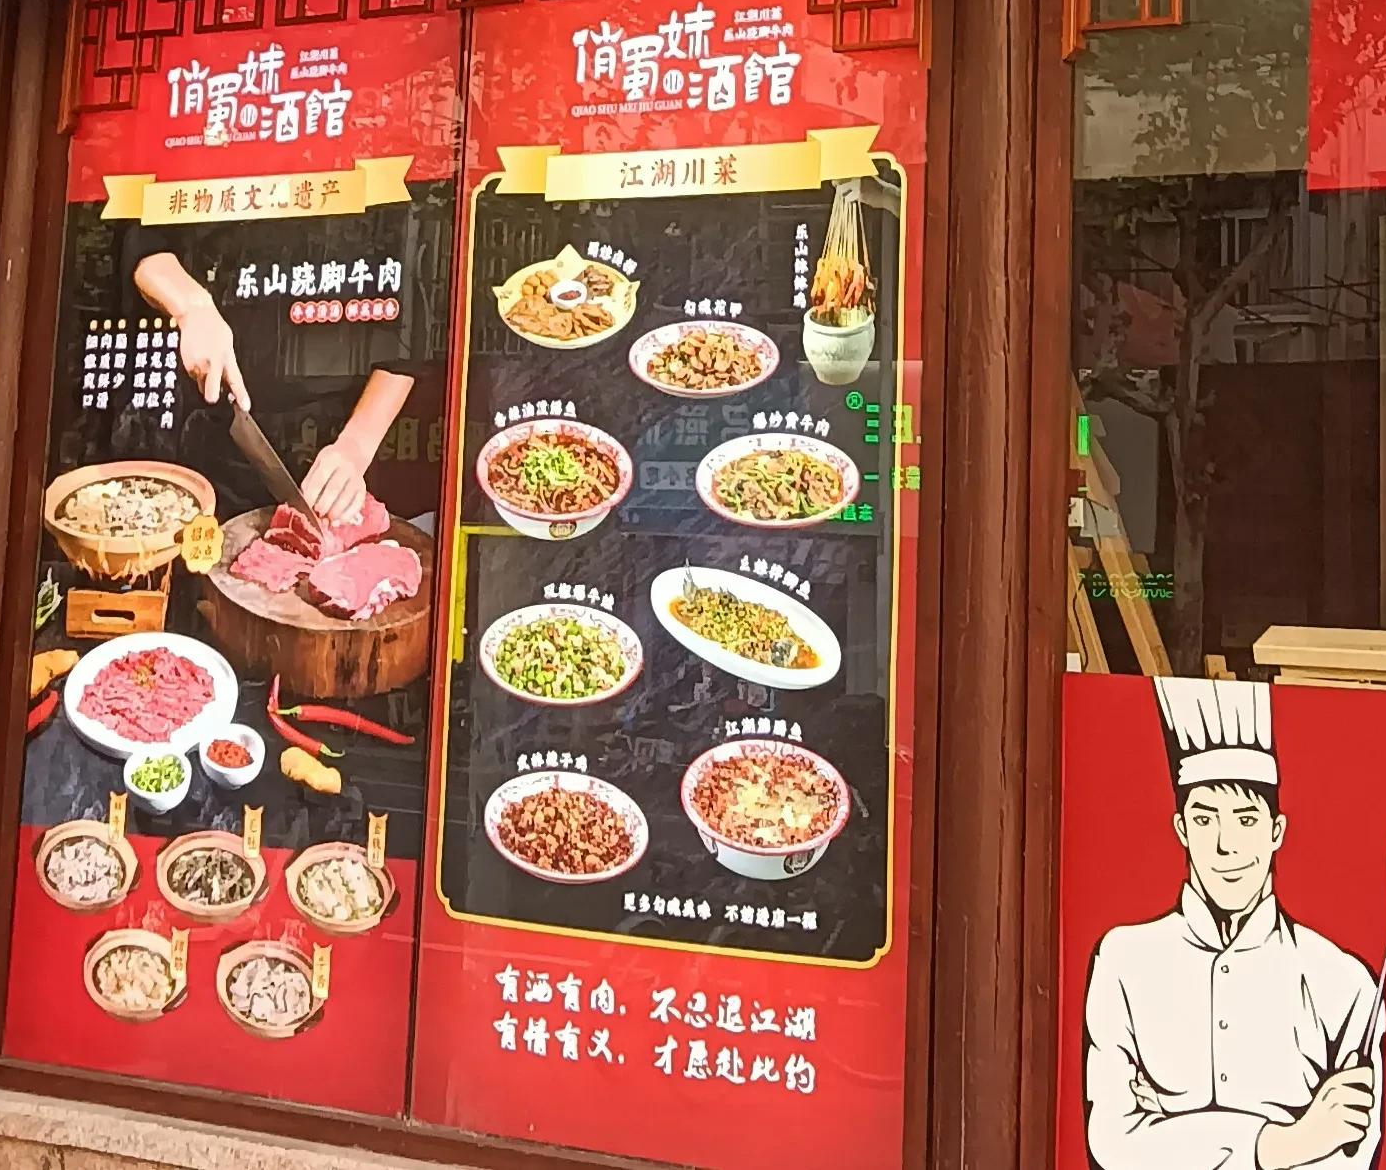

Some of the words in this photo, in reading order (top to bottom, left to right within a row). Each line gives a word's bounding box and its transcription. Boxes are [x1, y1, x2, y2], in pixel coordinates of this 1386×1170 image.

[571, 103, 596, 117] QIAO
[597, 102, 618, 115] SHU
[654, 99, 683, 111] GUAN
[619, 155, 739, 188] 江湖川菜
[236, 257, 402, 299] 乐山跷脚牛肉
